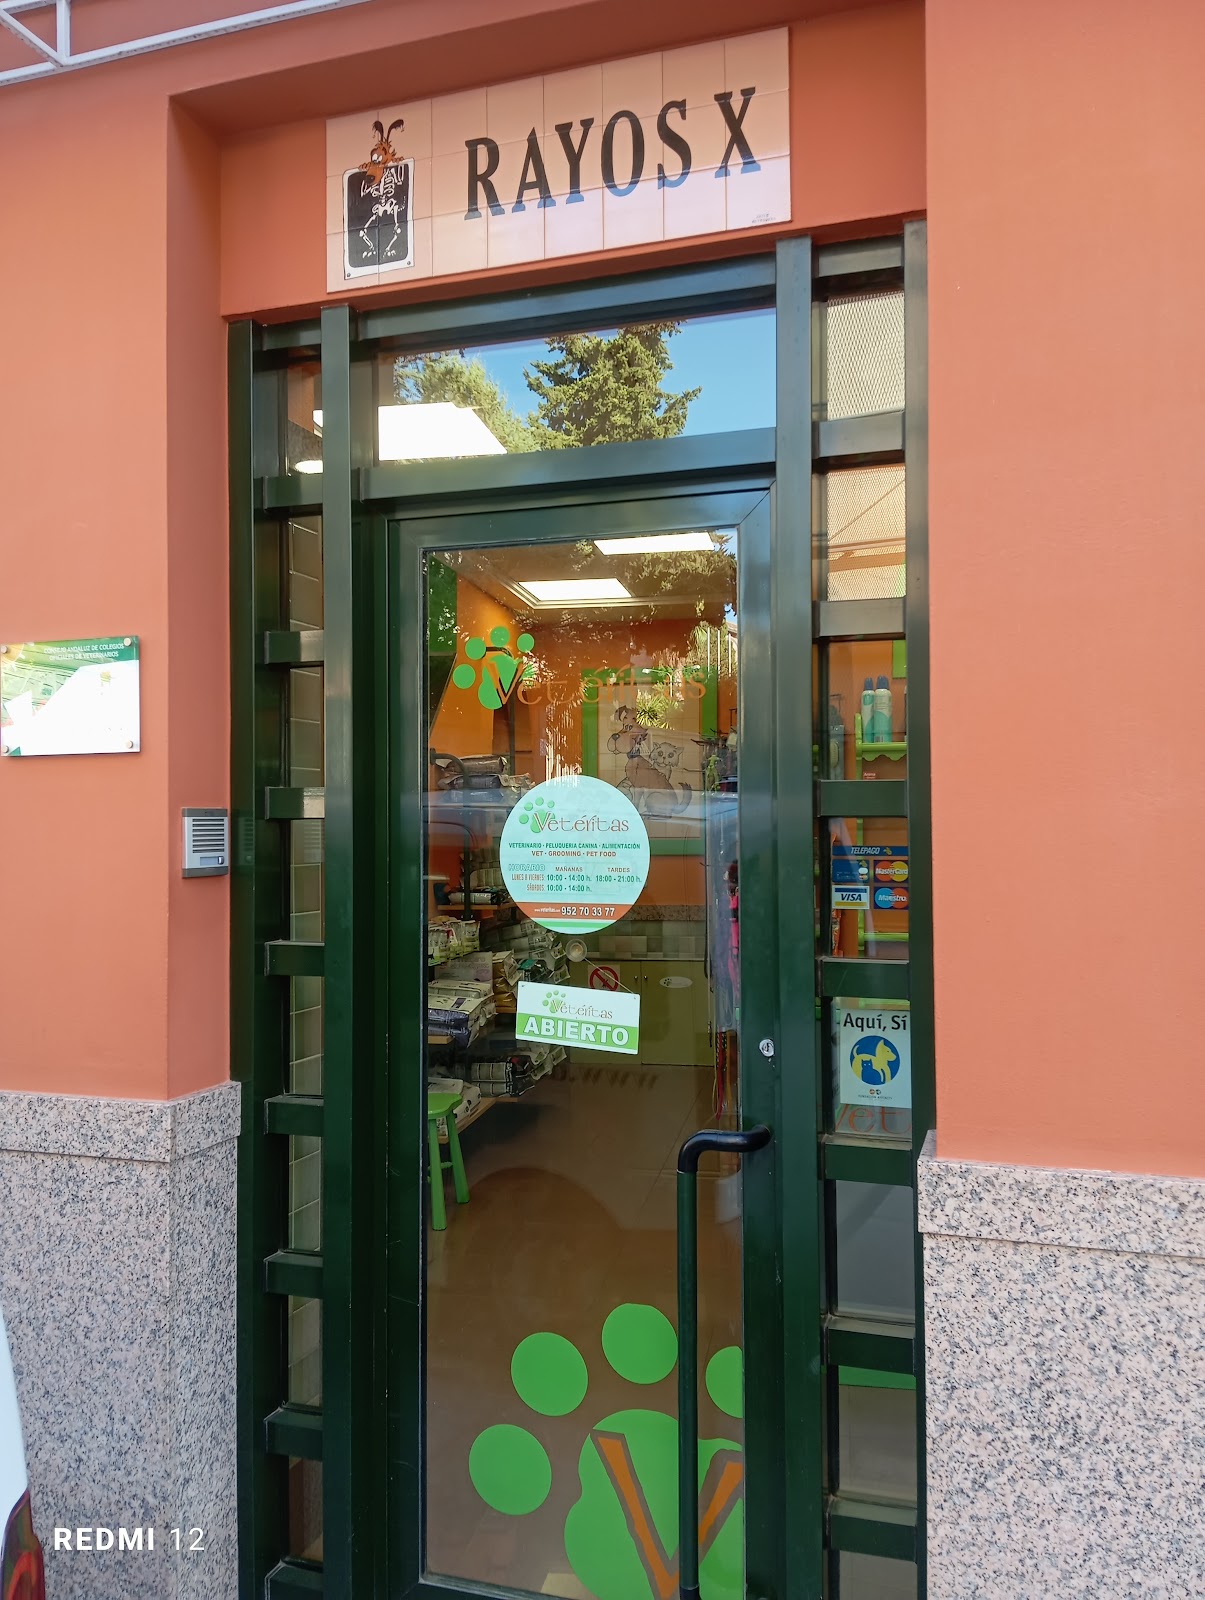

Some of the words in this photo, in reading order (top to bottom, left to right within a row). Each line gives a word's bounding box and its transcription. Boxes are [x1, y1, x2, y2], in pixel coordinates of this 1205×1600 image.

[464, 98, 693, 221] RAYOS
[713, 86, 762, 179] X
[83, 651, 119, 659] VETERINARIOS
[533, 811, 629, 832] Vetéritas
[601, 842, 640, 850] ALIMENTACIÓN
[508, 863, 545, 872] HORARIO
[511, 873, 524, 881] LUNES
[547, 874, 563, 882] 10:00
[568, 874, 585, 882] 14:00
[617, 875, 635, 883] 21:00
[547, 884, 563, 892] 10:00
[568, 884, 585, 892] 14:00
[841, 893, 862, 901] VISA
[561, 906, 577, 916] 952
[579, 906, 590, 916] 70
[592, 907, 602, 916] 33
[604, 907, 615, 916] 77
[843, 1012, 887, 1032] Aquí,
[891, 1014, 907, 1031] Sí
[523, 1016, 629, 1046] ABIERTO
